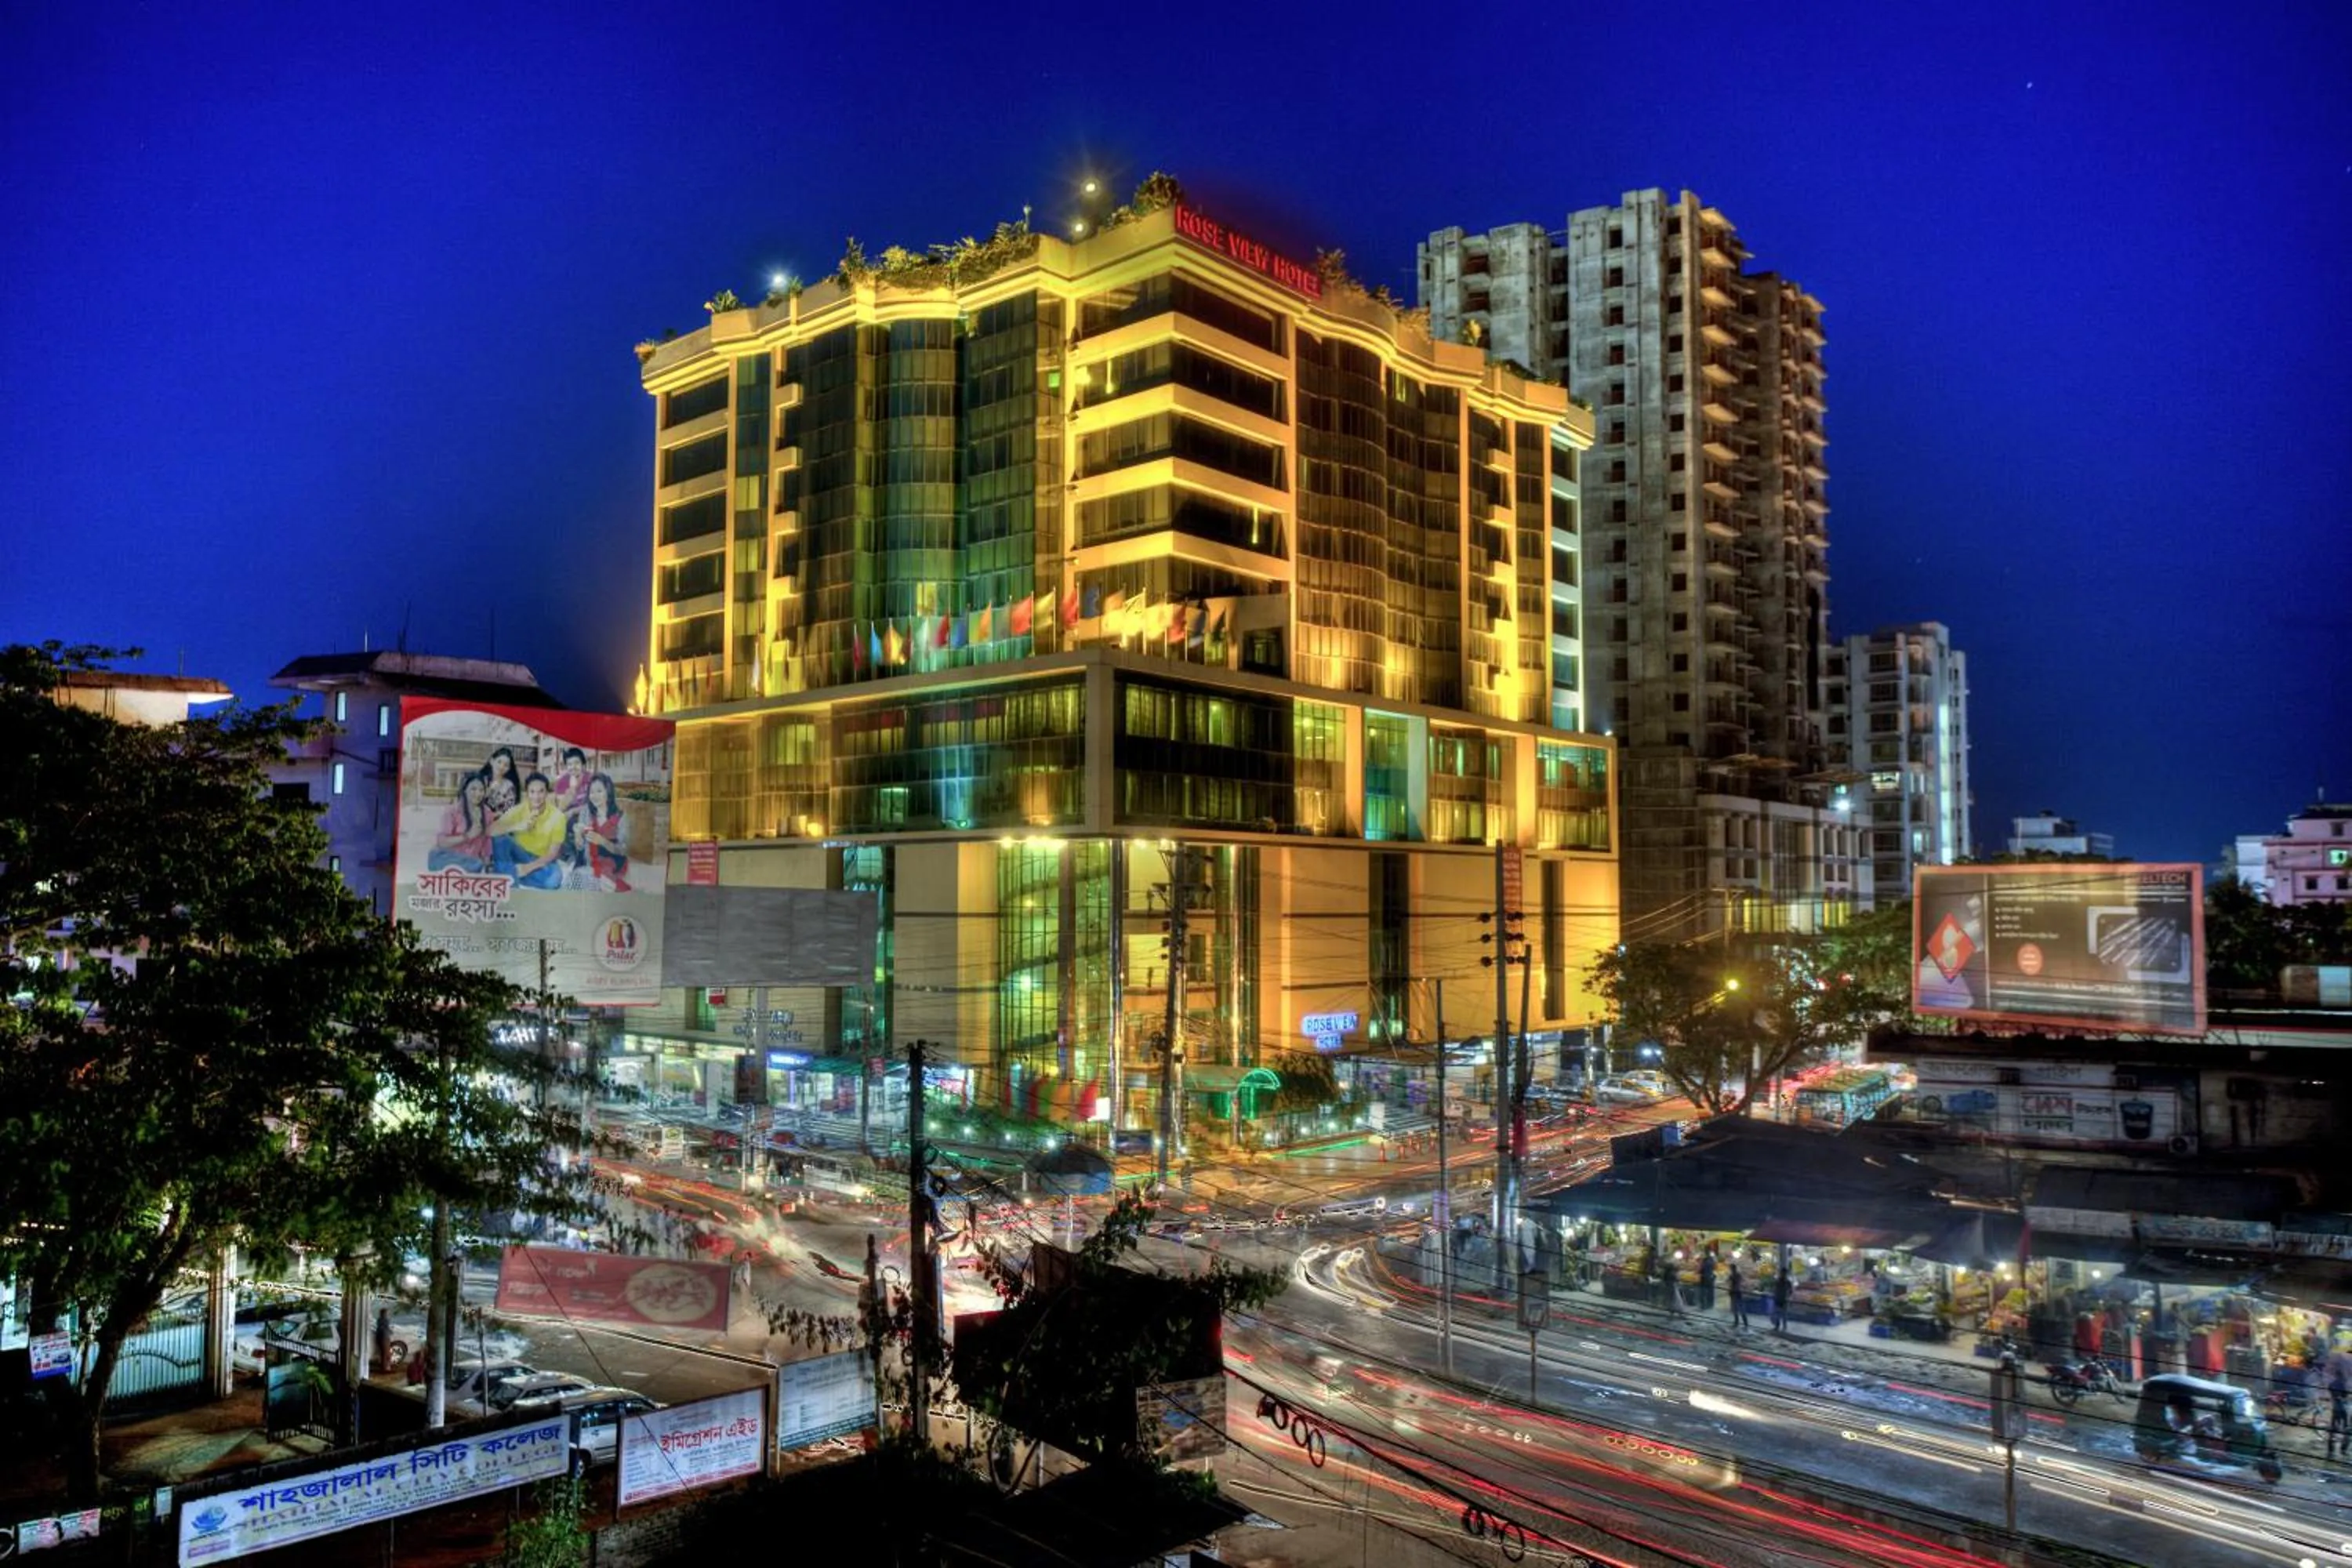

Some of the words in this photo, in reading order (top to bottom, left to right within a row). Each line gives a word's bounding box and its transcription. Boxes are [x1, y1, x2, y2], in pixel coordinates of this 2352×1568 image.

[1176, 204, 1225, 250] ROSE
[1229, 231, 1269, 271] VIEW
[1273, 254, 1321, 299] HOTEL
[417, 867, 510, 898] সাকিবের
[238, 1461, 397, 1512] শাহজালাল
[409, 1443, 469, 1475] সিটি
[480, 1423, 564, 1455] কলেজ
[659, 1426, 724, 1454] ইমিগ্রেশন
